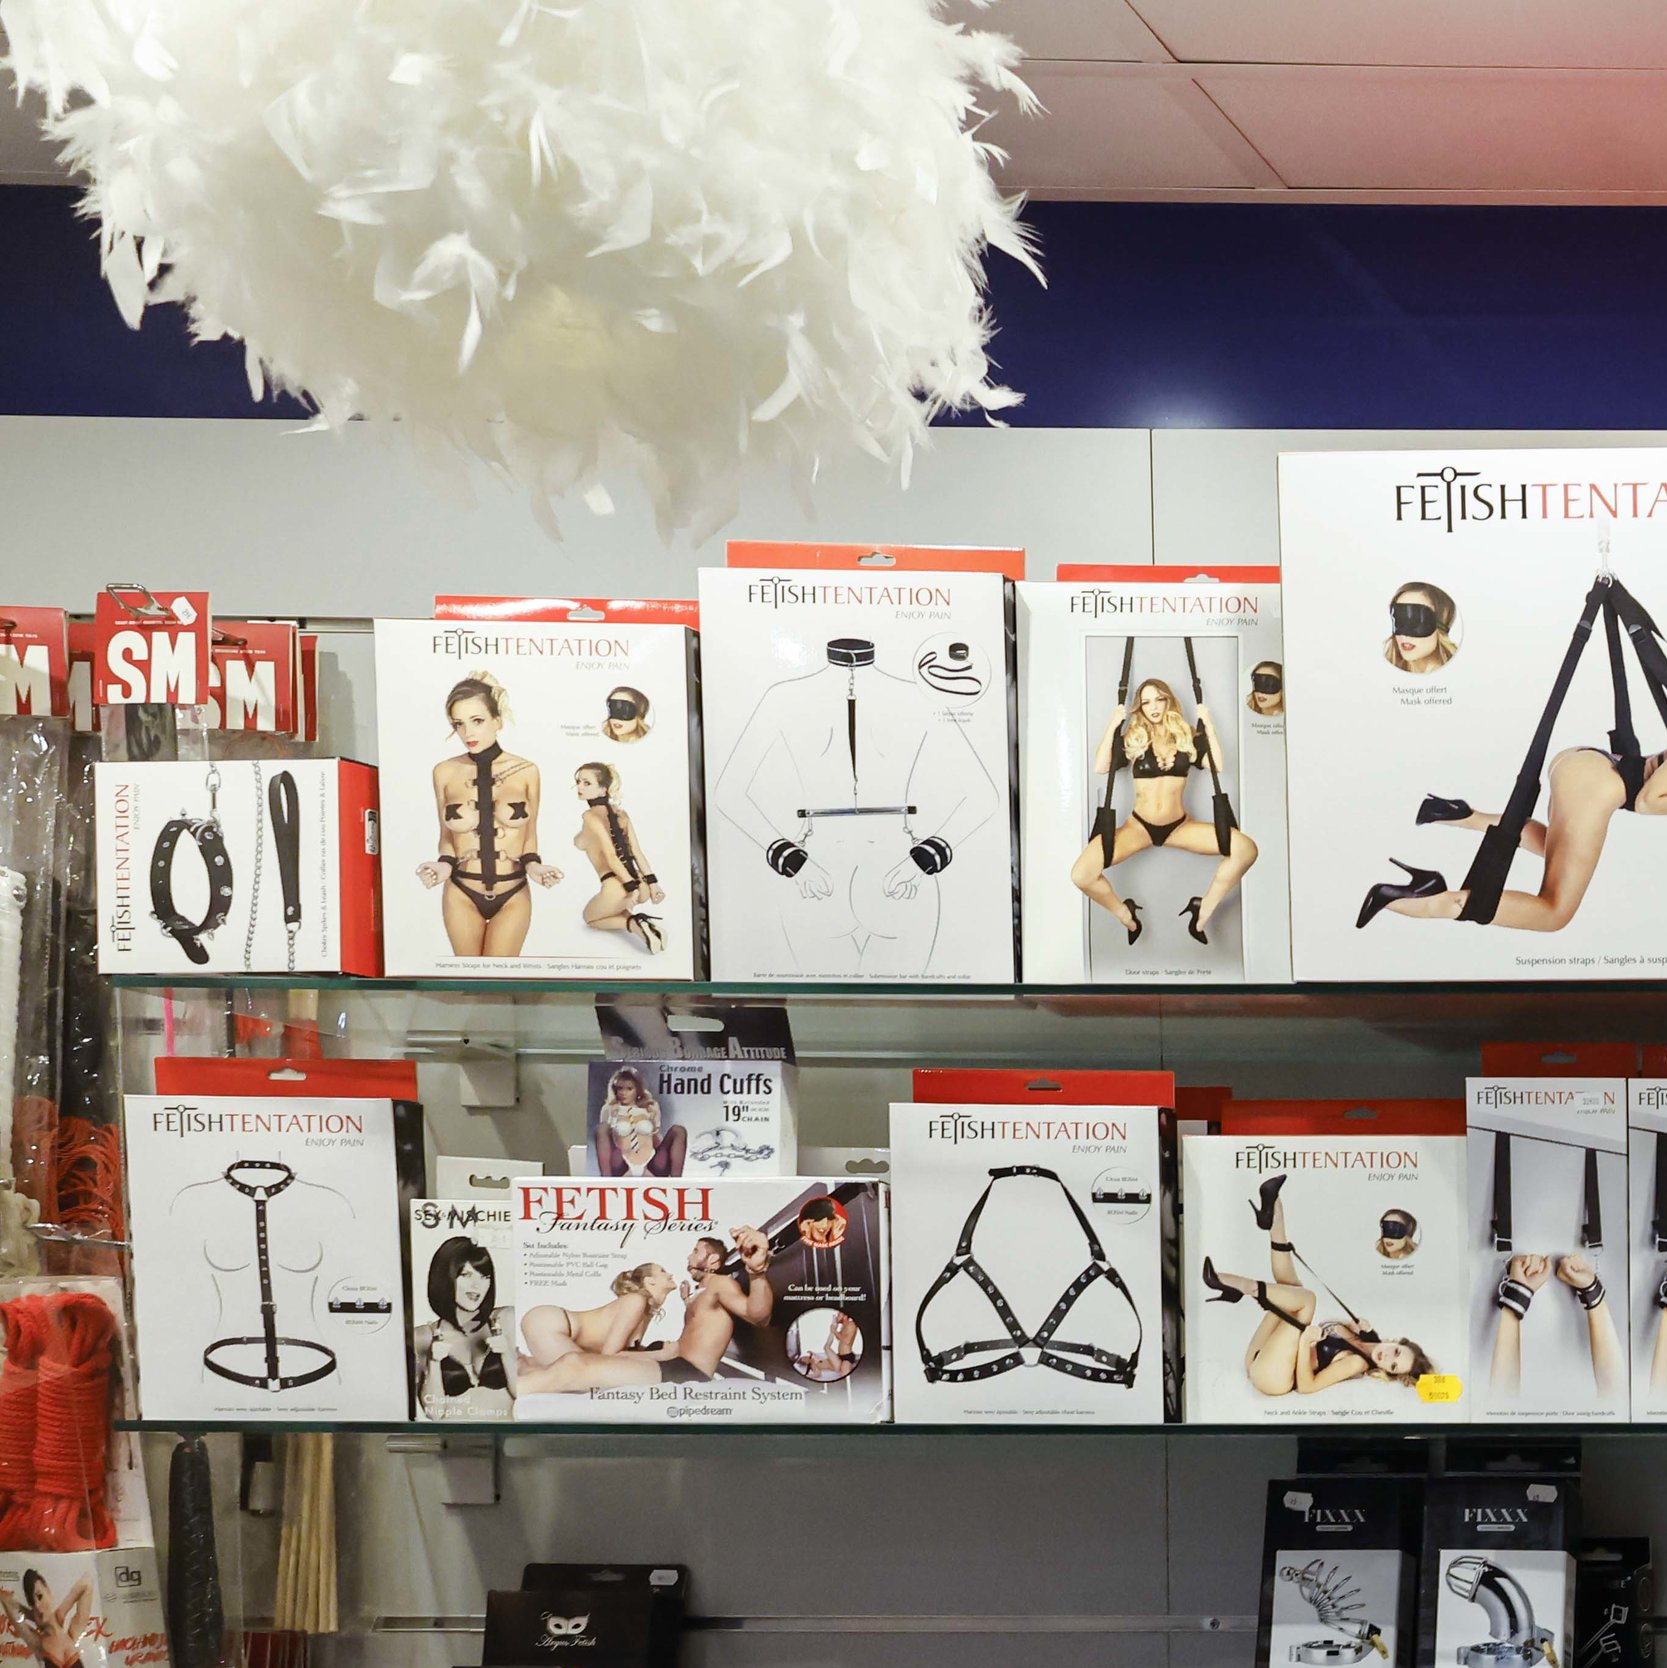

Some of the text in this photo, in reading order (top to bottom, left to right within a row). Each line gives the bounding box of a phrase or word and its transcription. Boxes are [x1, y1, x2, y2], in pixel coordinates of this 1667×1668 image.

[748, 576, 951, 609] FETISHTENTATION
[1071, 589, 1258, 618] FETISHTENTATION
[895, 611, 952, 622] ENJOY PAIN
[1206, 618, 1259, 627] ENJOY PAIN
[433, 628, 630, 660] FETISHTENTATION
[107, 630, 197, 704] SM
[1392, 685, 1447, 696] Masque offert
[1400, 697, 1453, 705] Mask offered
[111, 783, 135, 952] FETISHTENTATION
[1515, 956, 1566, 967] Suspension
[1568, 956, 1597, 967] straps
[1603, 955, 1636, 967] Sangles
[728, 1036, 789, 1060] ATTITUDE
[659, 1063, 704, 1073] Chrome
[659, 1073, 774, 1096] Hand Cuffs
[1477, 1086, 1616, 1110] FETISHTENTAN
[153, 1104, 365, 1138] FETISHTENTATION
[928, 1112, 1127, 1145] FETISHTENTATION
[306, 1138, 366, 1149] ENJOY PAIN
[1072, 1145, 1128, 1153] ENJOY PAIN
[1235, 1143, 1419, 1174] FETISHTENTATION
[1367, 1173, 1419, 1181] ENJOY PAIN
[518, 1187, 715, 1222] FETISH
[447, 1208, 512, 1222] MISCHIE
[537, 1212, 717, 1248] Fantasy Series
[589, 1386, 804, 1405] Fantasy Bed Restraint System
[677, 1406, 733, 1417] pipedream
[1303, 1508, 1366, 1524] FIXXX
[1464, 1508, 1530, 1524] FIXXX
